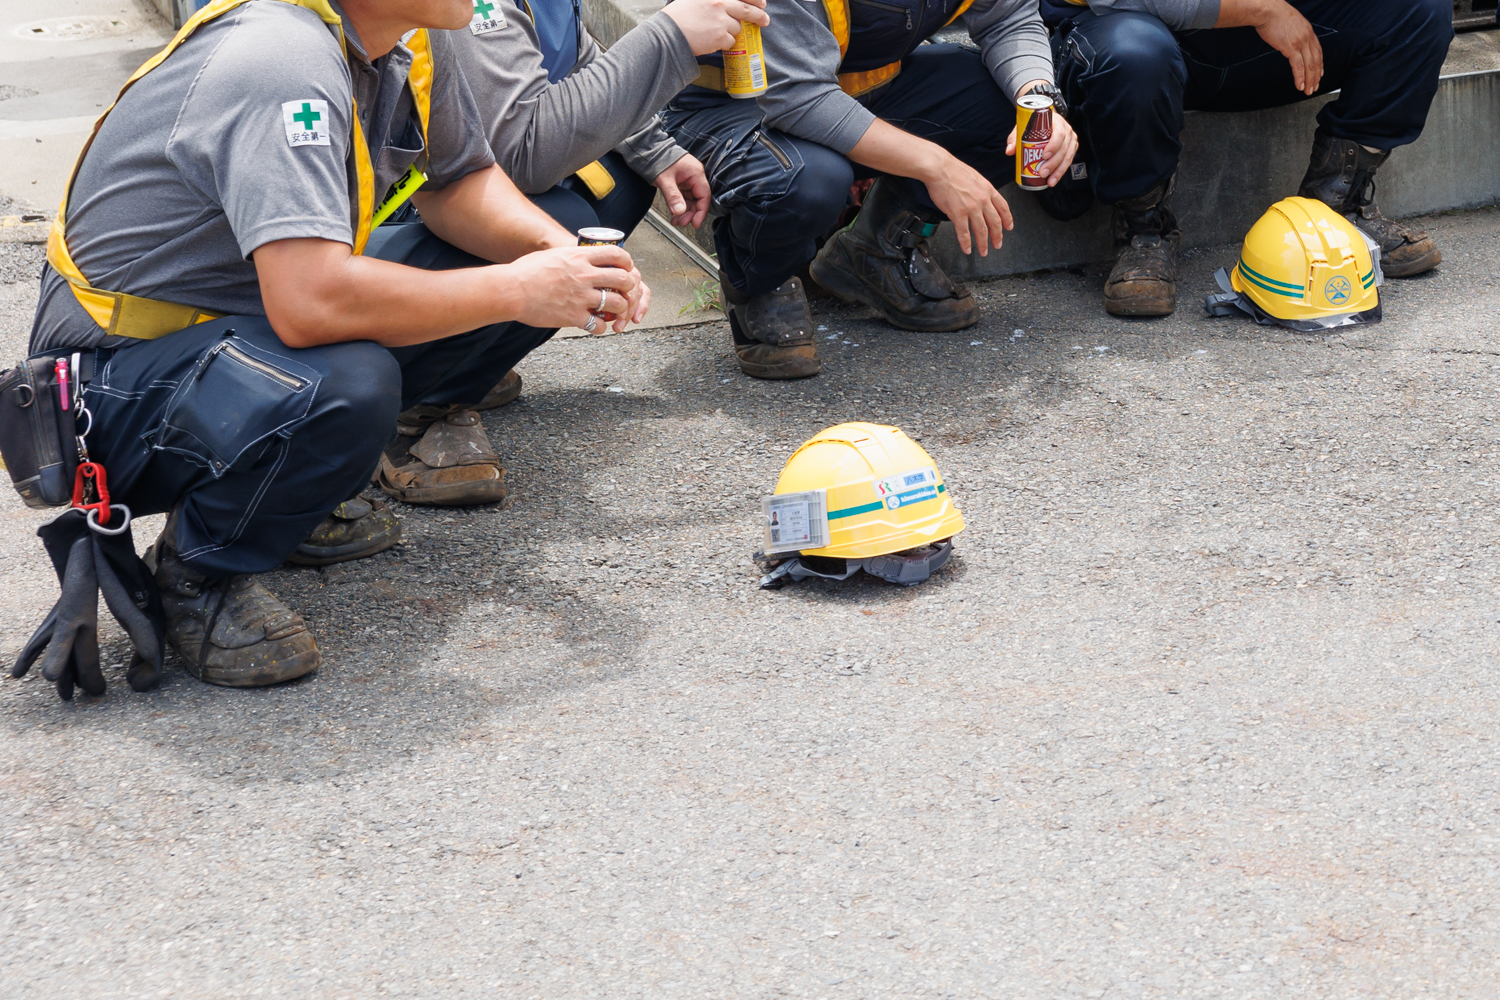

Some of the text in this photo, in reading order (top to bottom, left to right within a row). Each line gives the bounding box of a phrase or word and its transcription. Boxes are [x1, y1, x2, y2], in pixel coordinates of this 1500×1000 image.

[474, 18, 504, 32] 安全第一
[292, 132, 326, 143] 安全第一
